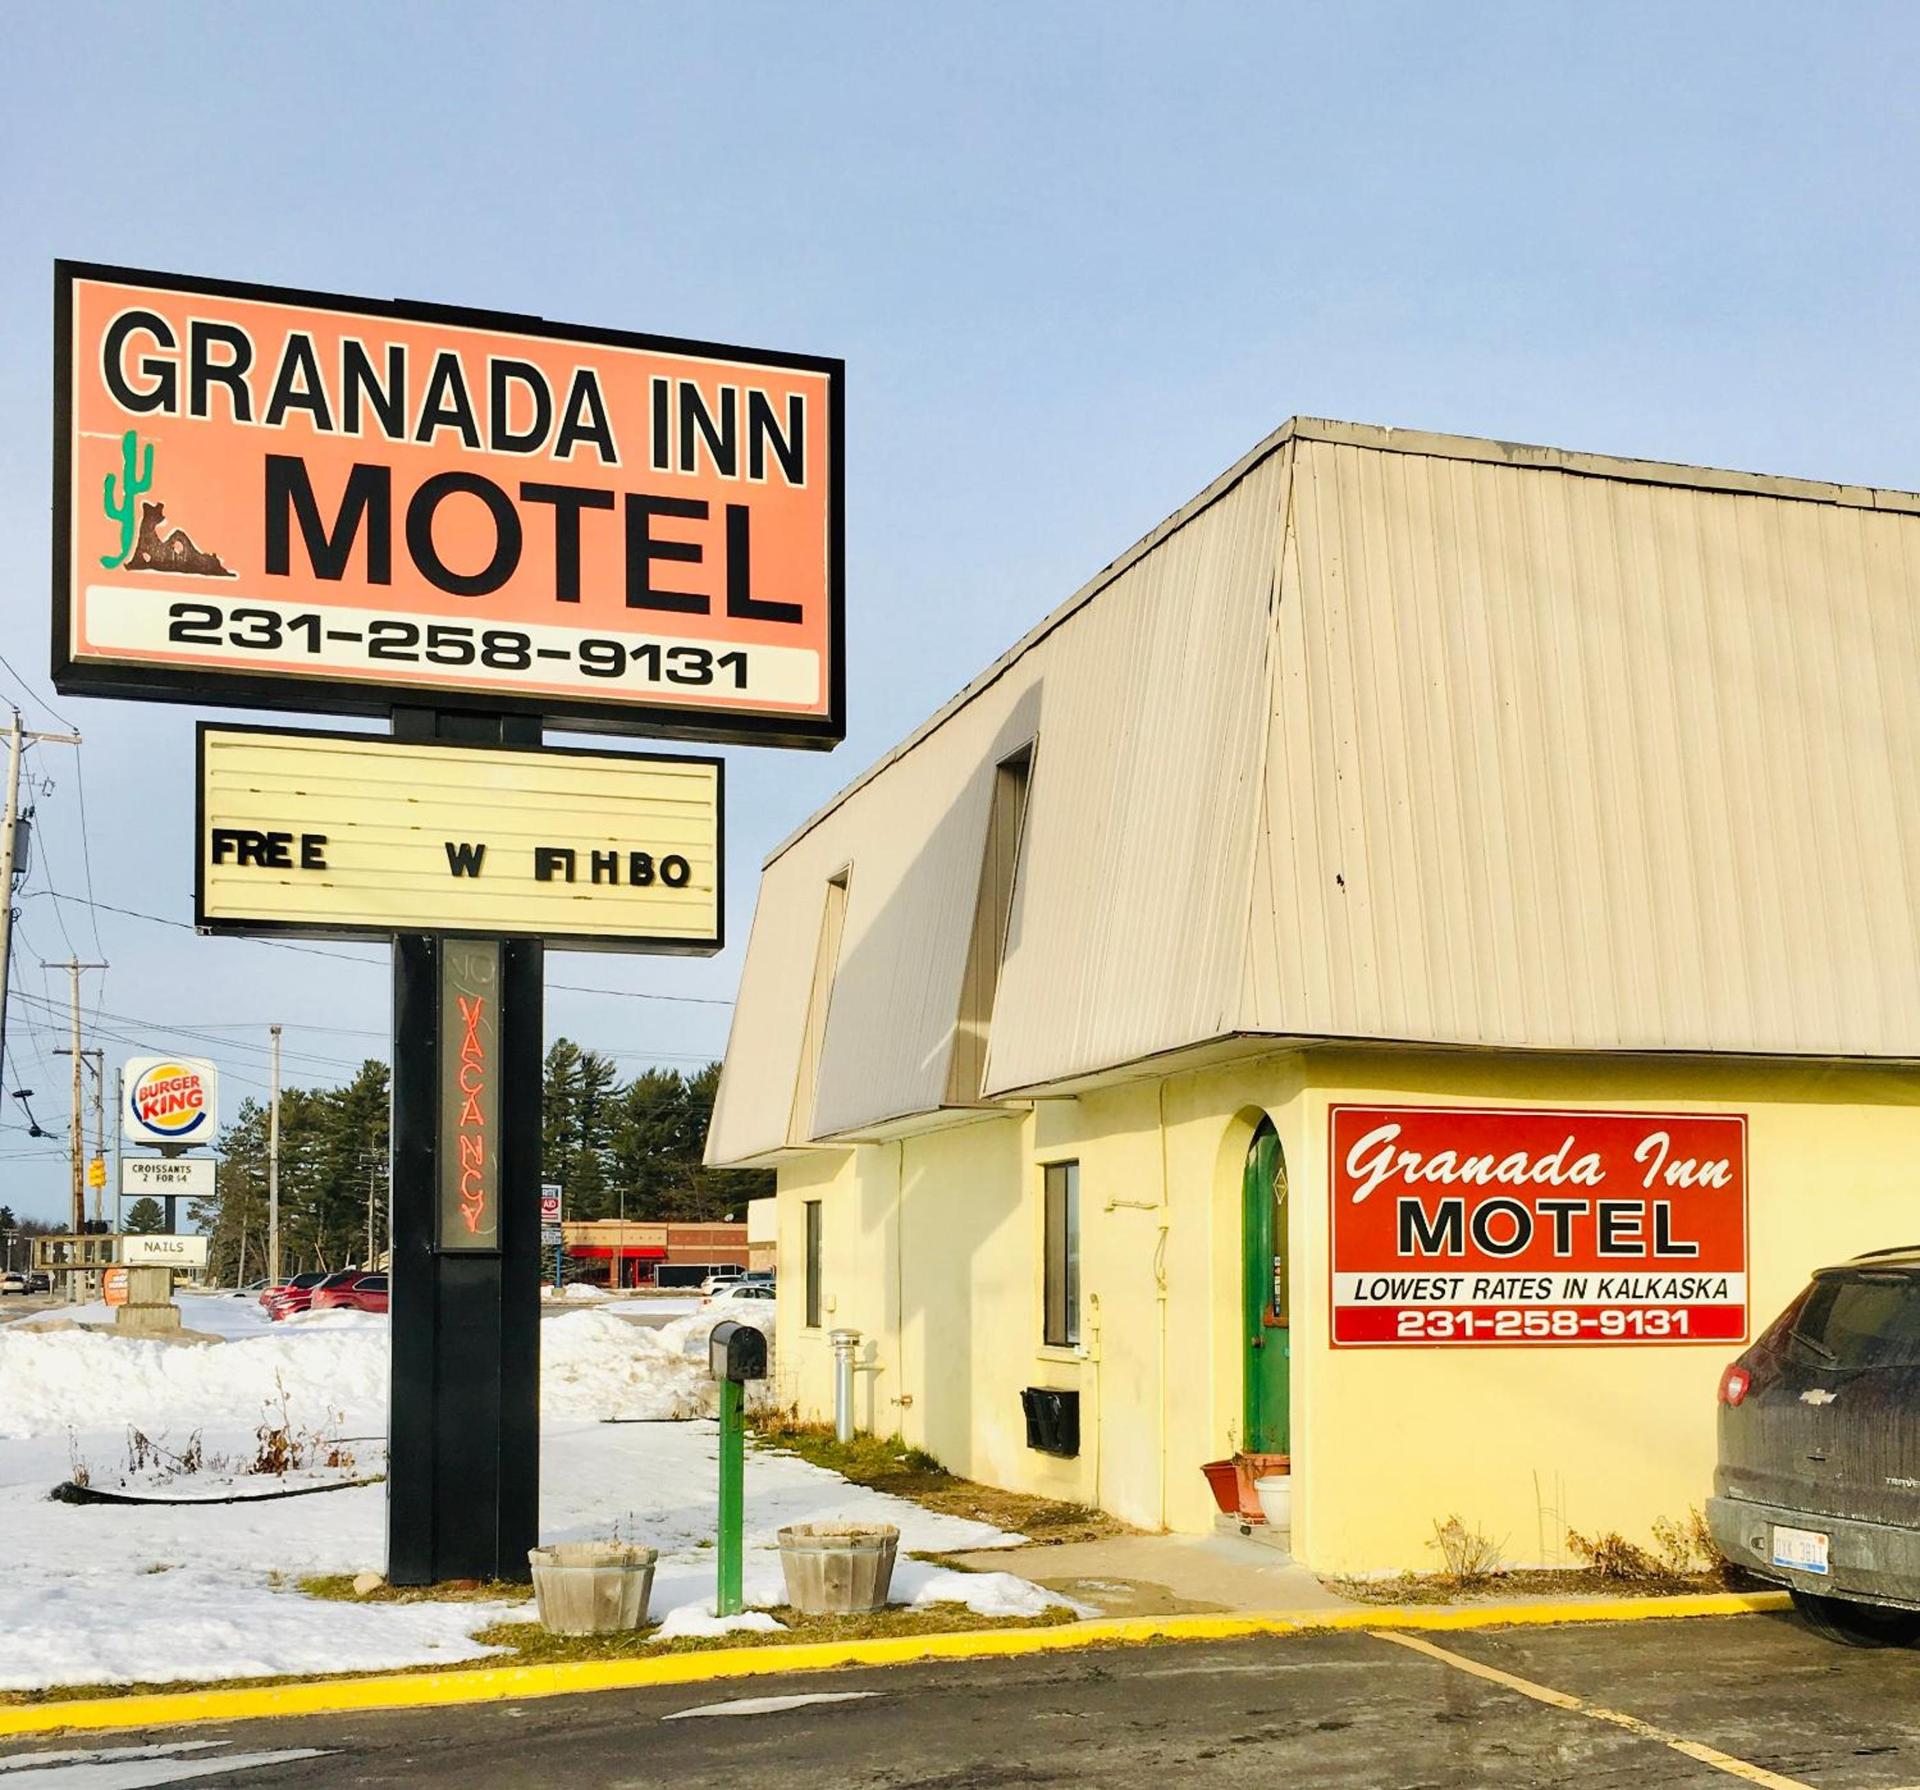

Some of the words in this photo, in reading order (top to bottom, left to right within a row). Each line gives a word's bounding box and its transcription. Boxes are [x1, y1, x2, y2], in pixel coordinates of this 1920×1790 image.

[101, 309, 620, 466] GRANADA
[648, 375, 807, 489] INN
[264, 453, 804, 625] MOTEL
[168, 602, 748, 690] 231-258-9131
[212, 828, 328, 869] FREE
[138, 1075, 201, 1103] BURGER
[142, 1089, 204, 1121] KING
[458, 995, 484, 1233] VACANCY
[131, 1164, 193, 1175] CROISSANTS
[142, 1173, 149, 1183] 2
[156, 1174, 175, 1183] FOR
[1345, 1123, 1607, 1204] Granada
[1633, 1131, 1733, 1190] Inn
[1396, 1196, 1700, 1258] MOTEL
[143, 1241, 185, 1253] NAILS
[1354, 1277, 1465, 1300] LOWEST
[1472, 1278, 1553, 1300] RATES
[1562, 1278, 1588, 1299] IN
[1598, 1278, 1729, 1300] KALKASKA
[1396, 1309, 1690, 1338] 231-258-9131
